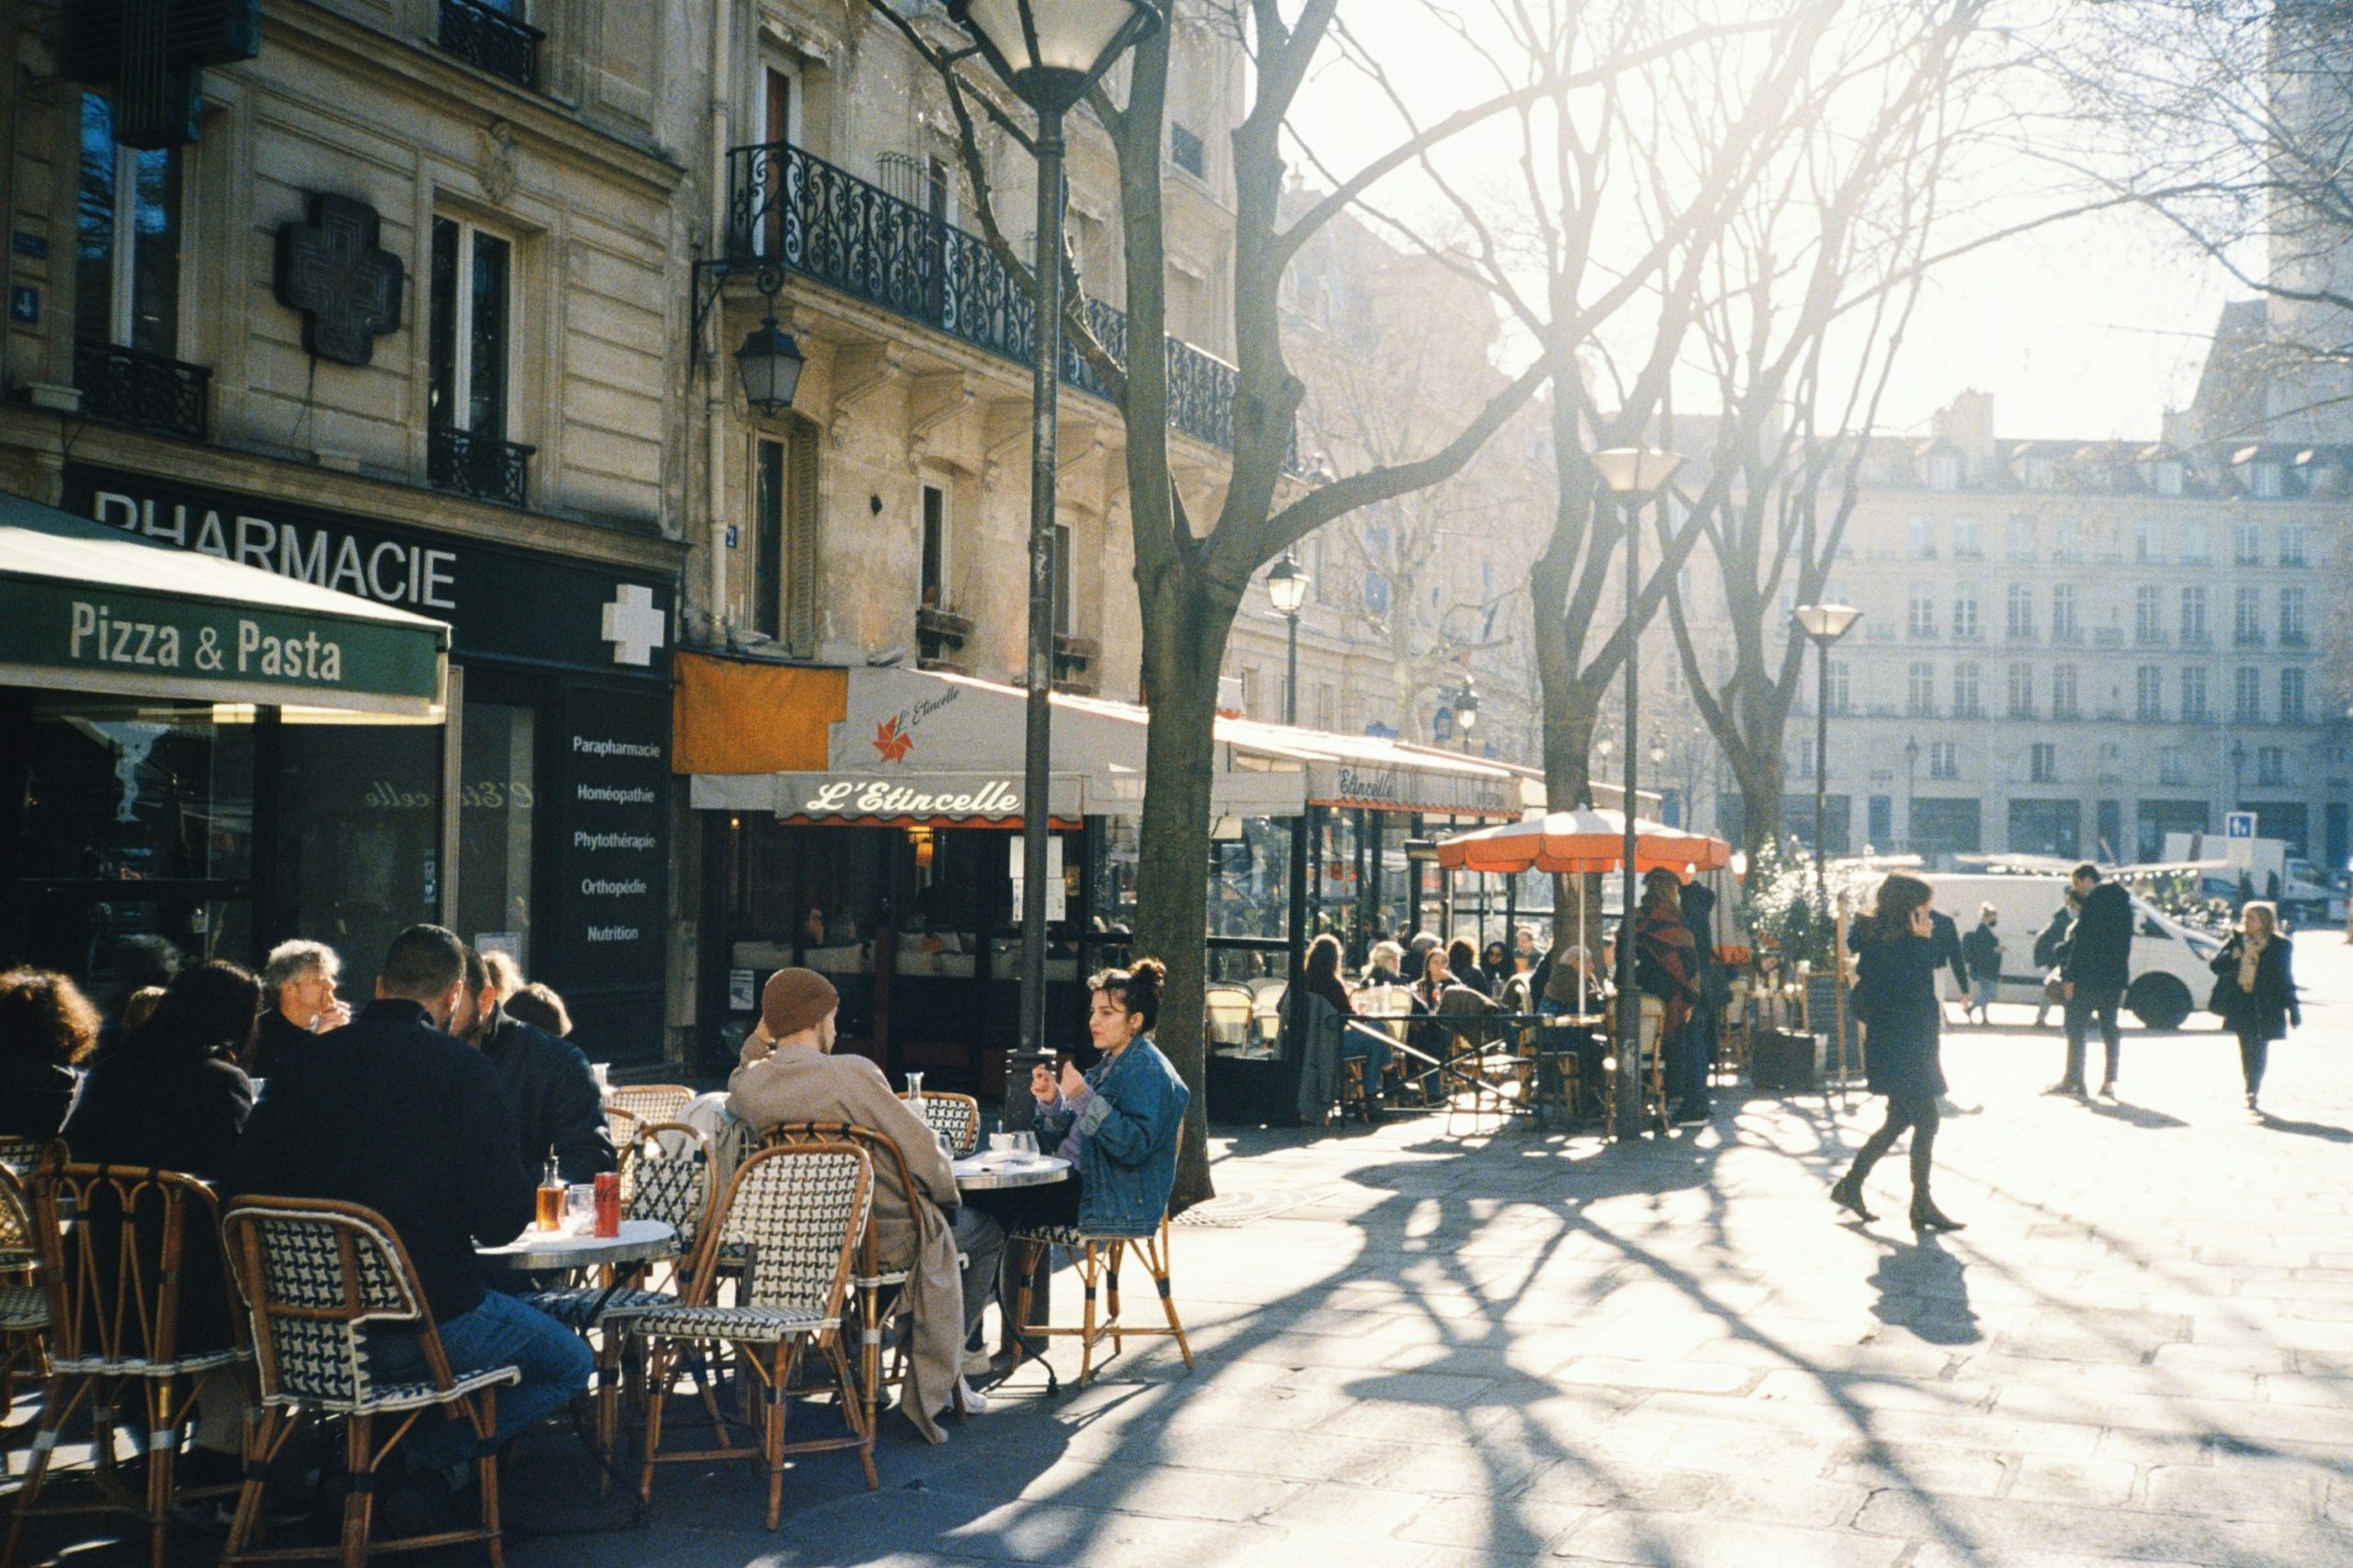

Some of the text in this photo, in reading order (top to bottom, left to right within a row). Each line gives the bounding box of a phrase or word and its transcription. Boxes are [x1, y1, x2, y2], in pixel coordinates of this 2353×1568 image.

[17, 290, 33, 318] 4
[94, 491, 457, 609] PHARMACIE
[71, 601, 341, 682] Pizza & Pasta
[573, 736, 661, 757] Parapharmacie
[577, 783, 655, 805] Homéopathie
[806, 780, 1021, 812] L'Etincelle
[574, 831, 656, 851] Phytothérapie
[581, 878, 647, 897] Orthopédie
[587, 925, 639, 942] Nutrition
